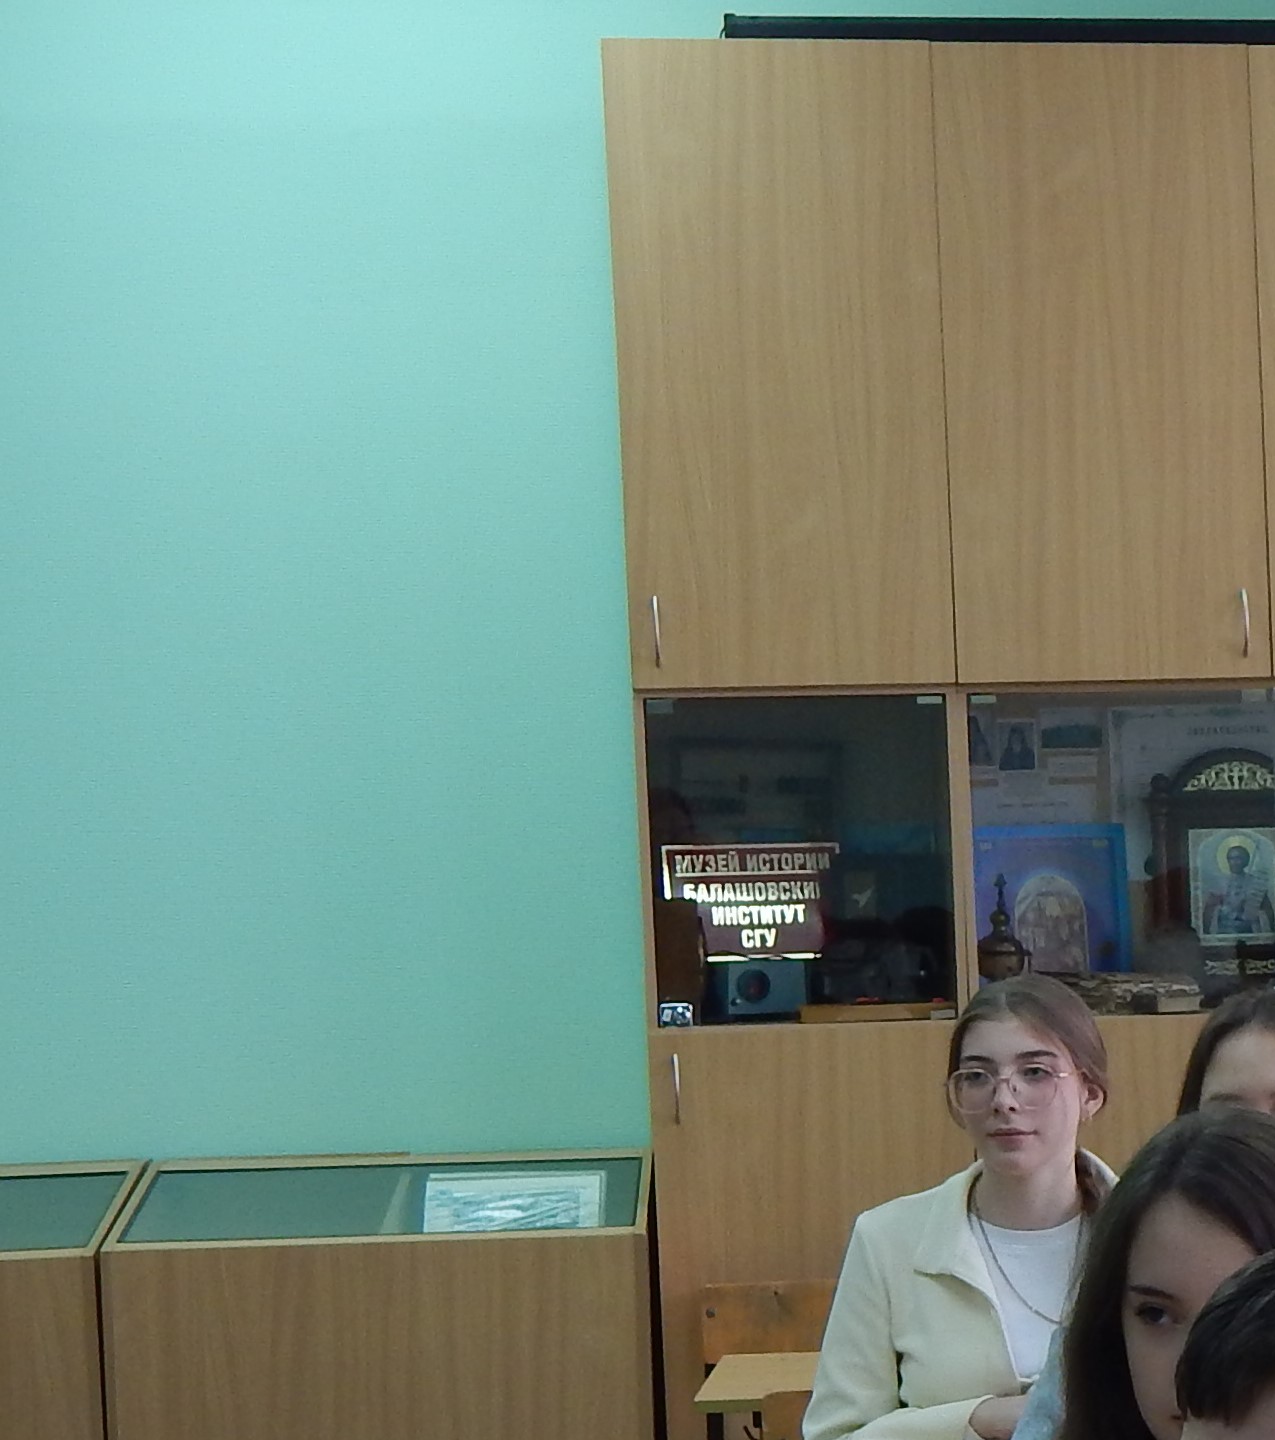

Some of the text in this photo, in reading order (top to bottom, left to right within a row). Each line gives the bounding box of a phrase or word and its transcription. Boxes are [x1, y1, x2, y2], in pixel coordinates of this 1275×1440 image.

[675, 851, 830, 873] МУЗЕЙ ИСТОРИИ
[711, 904, 806, 926] ИНСТИТУТ
[741, 928, 777, 948] СГУ
